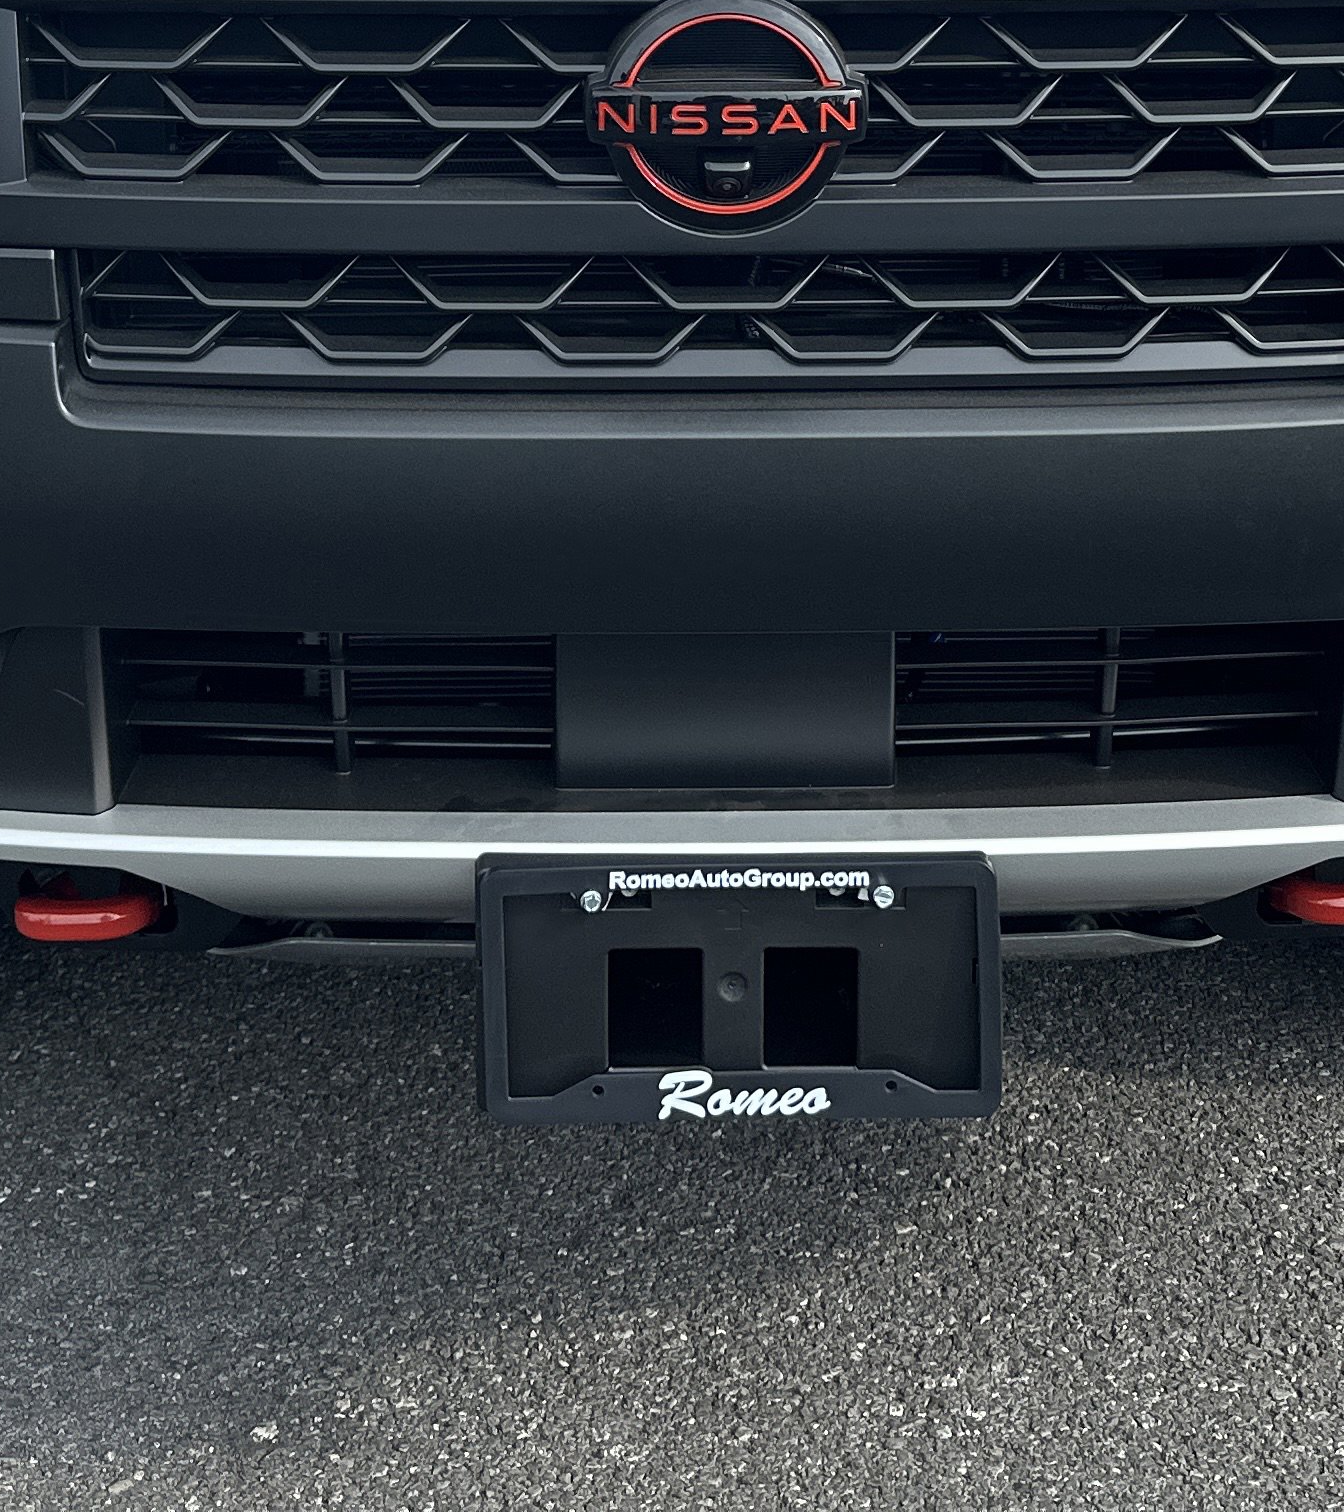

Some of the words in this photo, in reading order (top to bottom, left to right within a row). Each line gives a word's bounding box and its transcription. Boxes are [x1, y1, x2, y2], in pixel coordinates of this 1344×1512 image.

[597, 101, 857, 135] NISSAN
[609, 869, 870, 890] RomeoAutoGroup.com
[658, 1070, 831, 1120] Romeo
